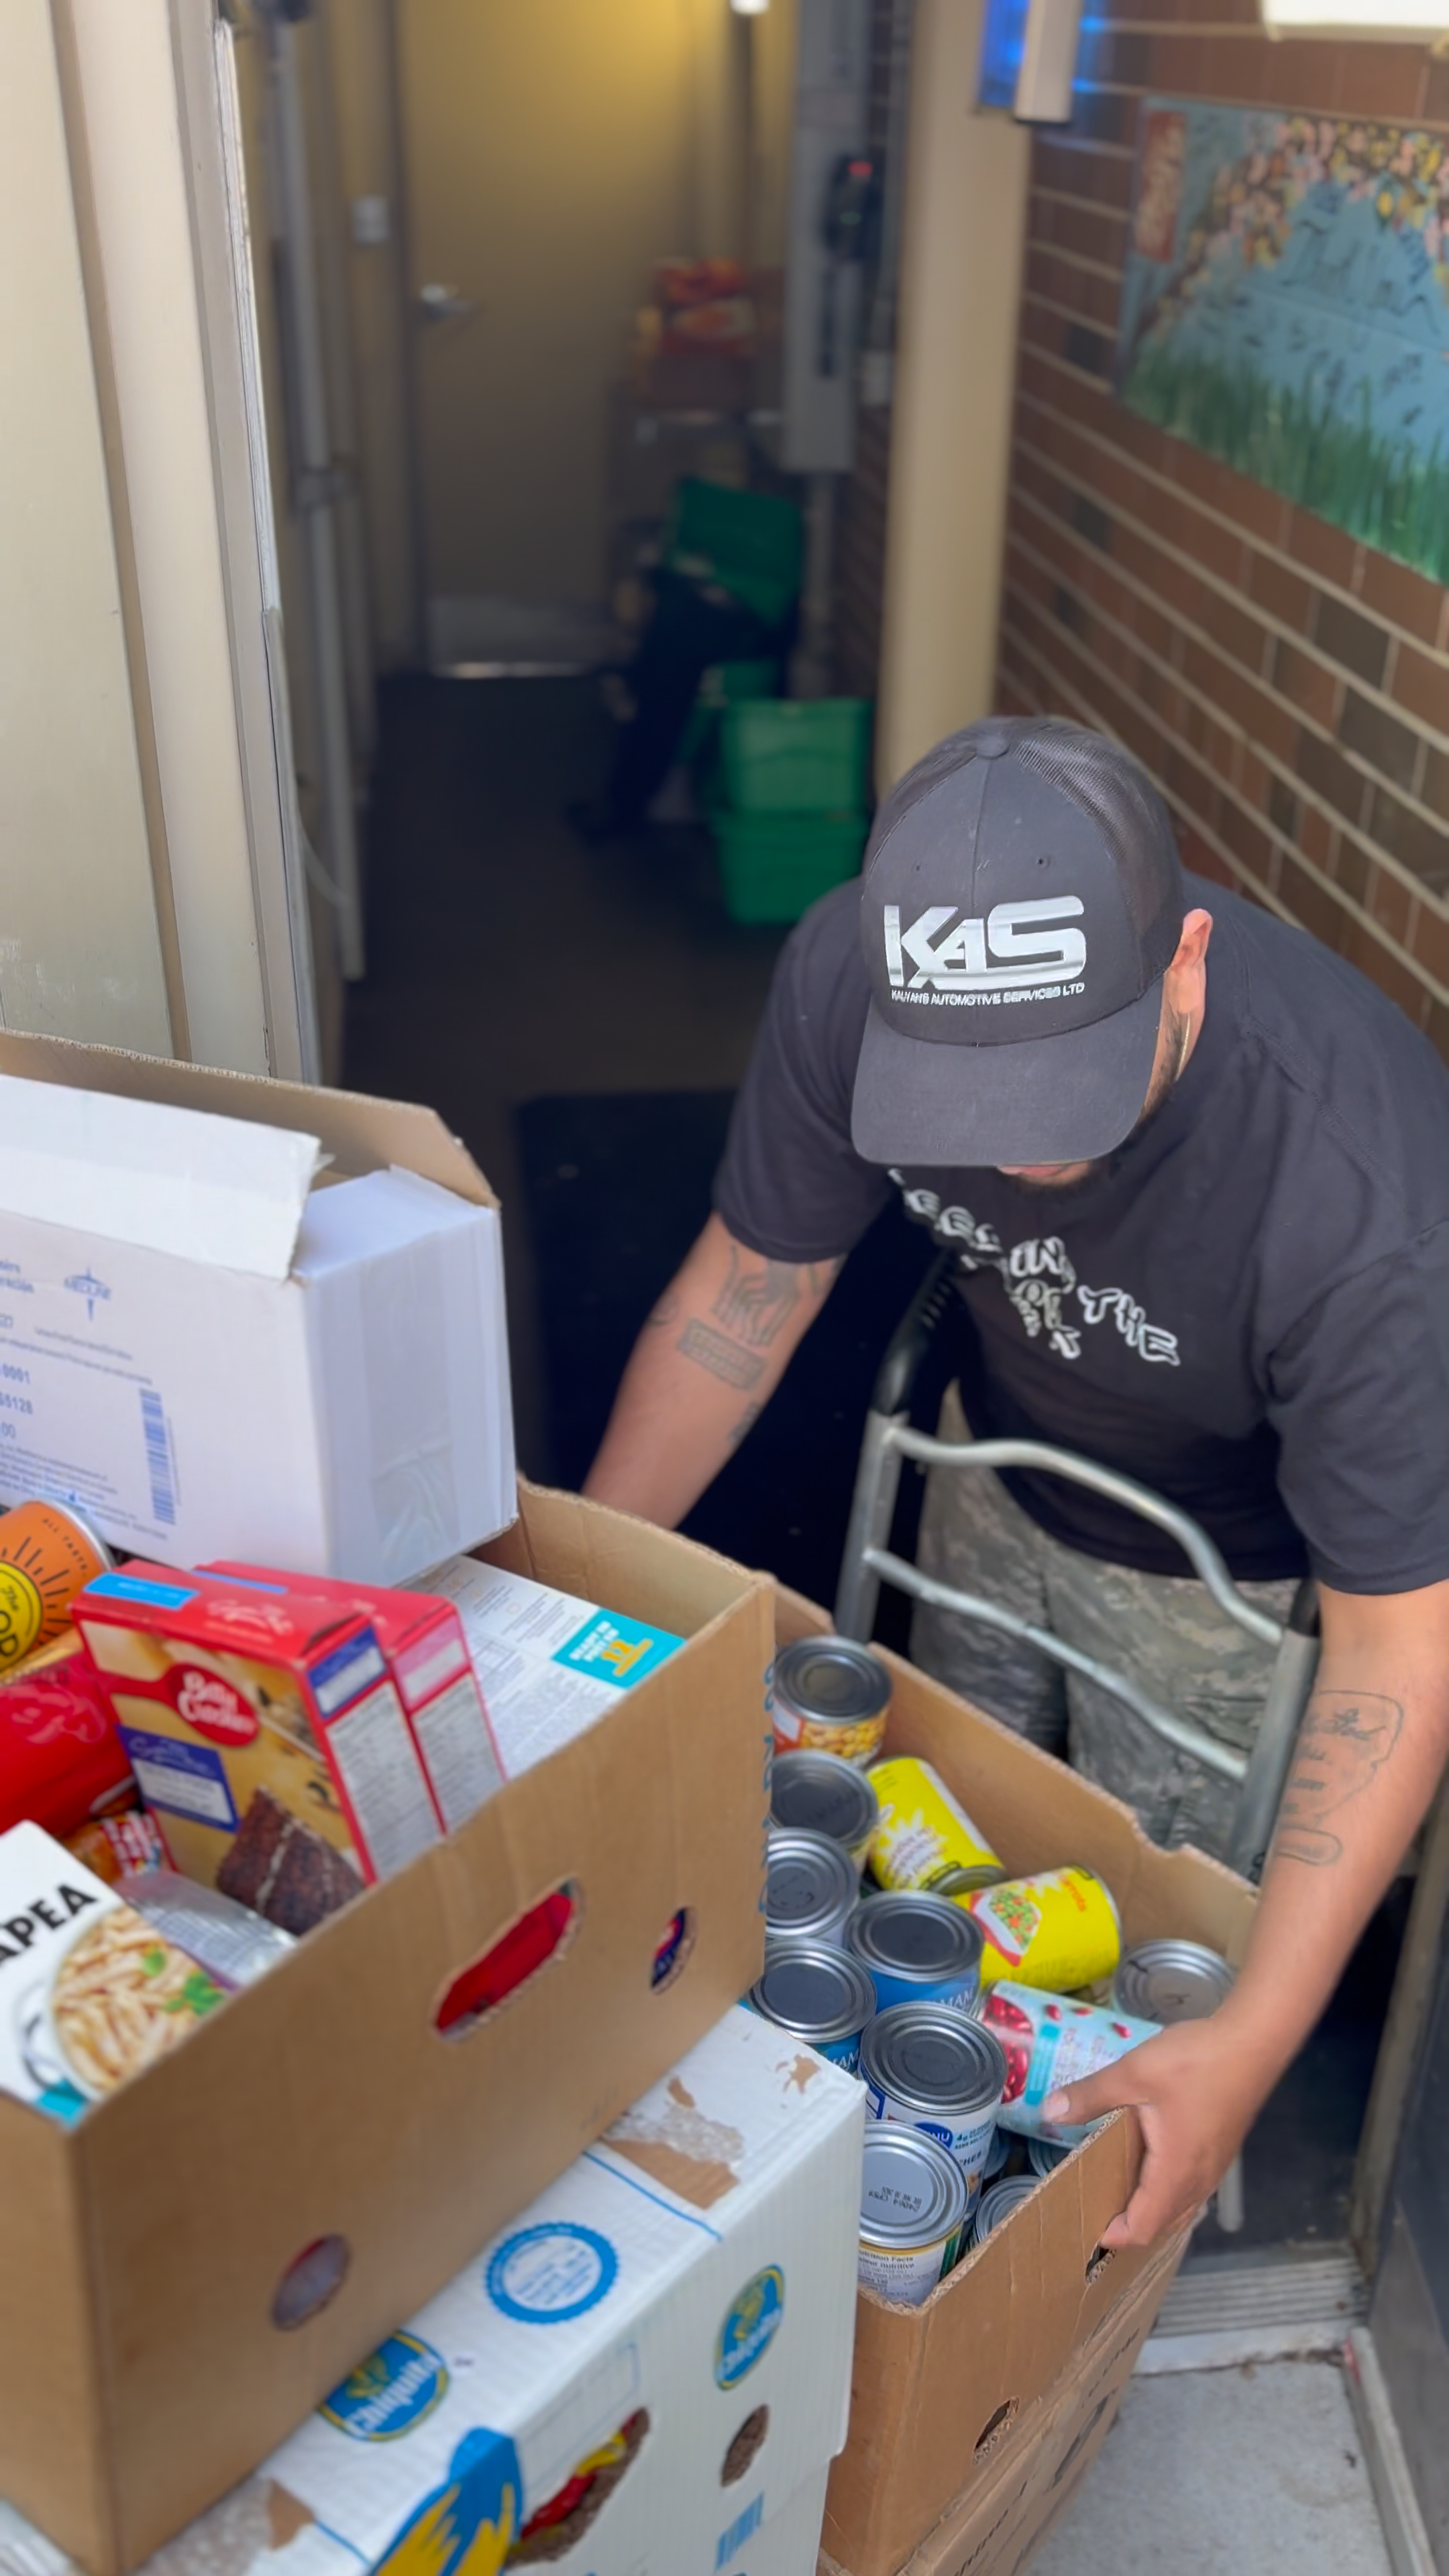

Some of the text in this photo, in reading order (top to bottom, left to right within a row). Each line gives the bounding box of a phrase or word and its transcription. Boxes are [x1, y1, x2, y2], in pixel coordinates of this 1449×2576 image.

[883, 896, 1087, 990] KAS
[930, 992, 1000, 1006] AUTOMOTIVE
[1003, 987, 1061, 1004] SERVICES
[1063, 982, 1085, 996] LTD
[1077, 1285, 1181, 1366] THE
[0, 1362, 30, 1385] 0001
